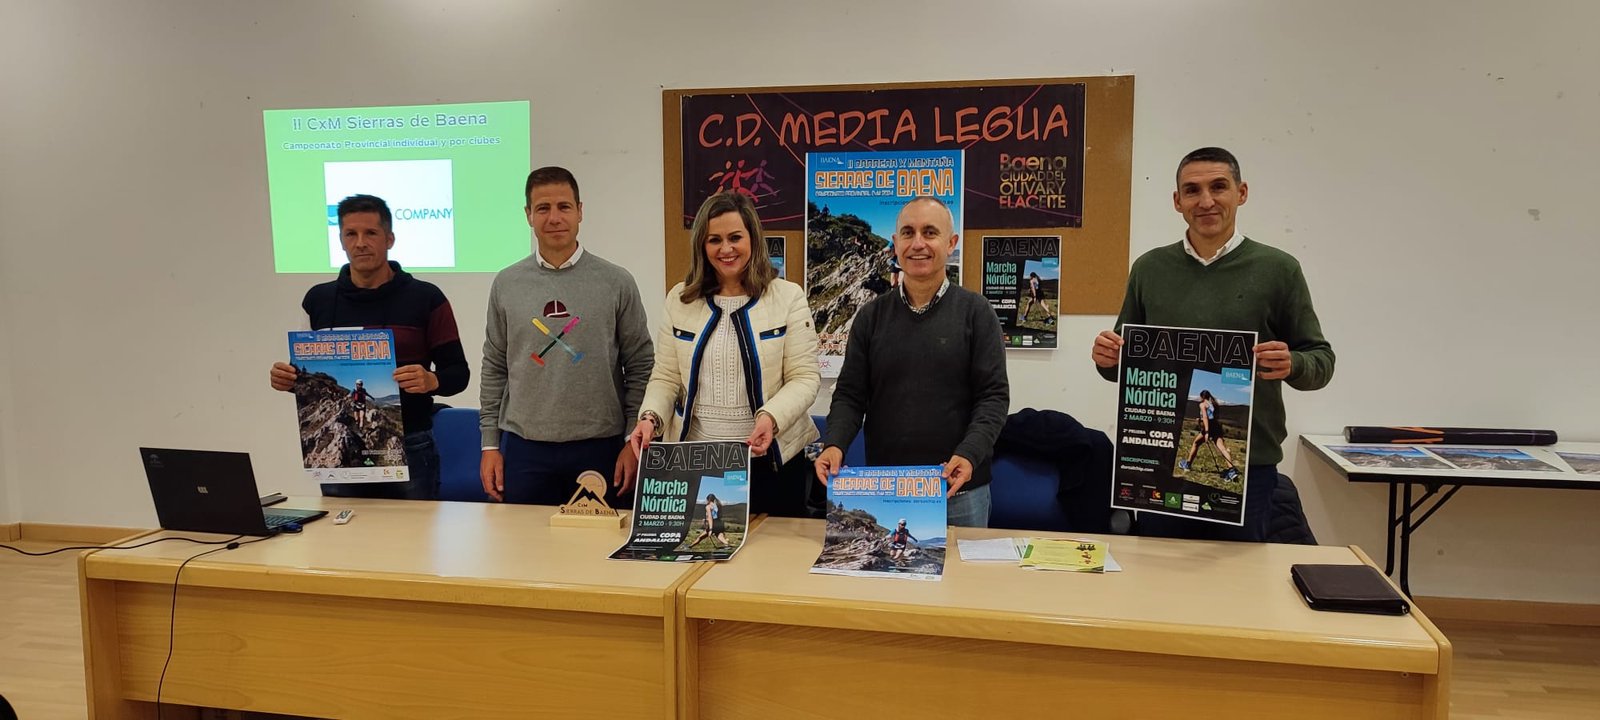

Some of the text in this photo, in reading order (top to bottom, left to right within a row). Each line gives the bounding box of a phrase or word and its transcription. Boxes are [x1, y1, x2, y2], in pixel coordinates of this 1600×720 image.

[307, 117, 341, 130] CxM
[347, 115, 404, 129] Sierras
[410, 114, 430, 127] de
[436, 113, 487, 127] Baena
[699, 104, 1069, 147] C.D. MEDIA LEGUA
[283, 141, 341, 151] Campeonato
[345, 140, 391, 149] Provincial
[393, 138, 437, 148] individual
[449, 138, 465, 147] por
[469, 136, 500, 145] clubes
[1000, 153, 1067, 171] Baena
[815, 168, 955, 197] SIERRAS DE BAENA
[395, 208, 453, 221] COMPANY
[985, 238, 1058, 257] BAENA
[986, 261, 1017, 273] Marcha
[986, 273, 1017, 285] Nórdica
[351, 340, 392, 360] BAENA
[1127, 328, 1250, 366] BAENA
[1126, 367, 1178, 389] Marcha
[1125, 387, 1177, 409] Nórdica
[1149, 430, 1174, 440] COPA
[645, 443, 746, 471] BAENA
[642, 478, 689, 496] Marcha
[832, 478, 879, 490] SIERRAS
[880, 478, 895, 490] DE
[896, 477, 942, 497] BAENA
[640, 495, 687, 513] Nórdica
